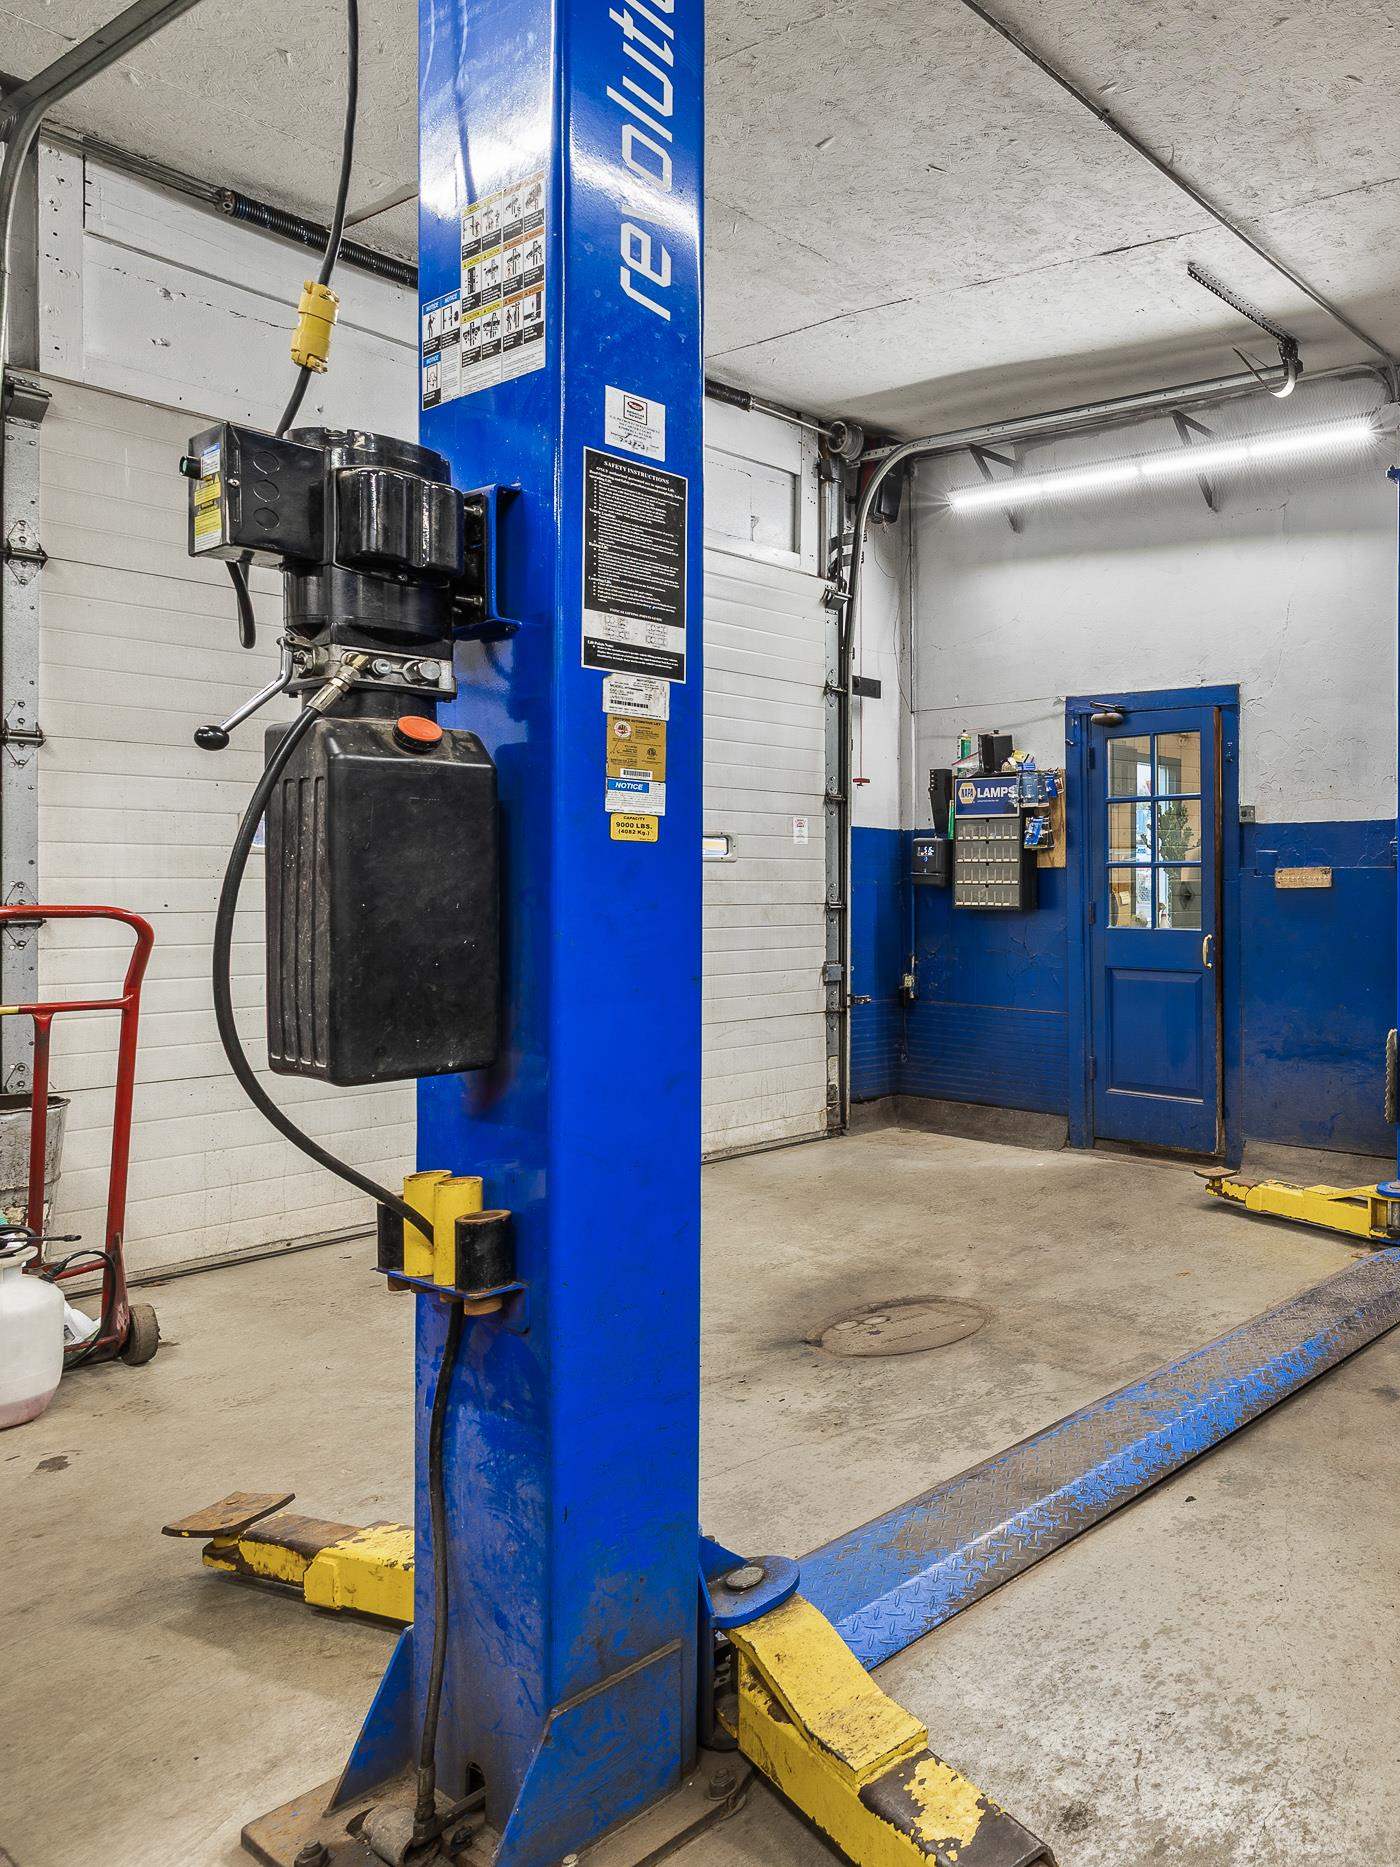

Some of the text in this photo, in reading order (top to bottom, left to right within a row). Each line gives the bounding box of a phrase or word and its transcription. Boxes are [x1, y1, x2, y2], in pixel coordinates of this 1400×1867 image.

[606, 0, 675, 321] reoluti
[603, 460, 670, 485] SAFETY INSTRUCTIONS
[614, 781, 644, 791] NOTICE
[961, 785, 1016, 798] NAPA LAMPS
[616, 821, 653, 830] 9000 LBS.
